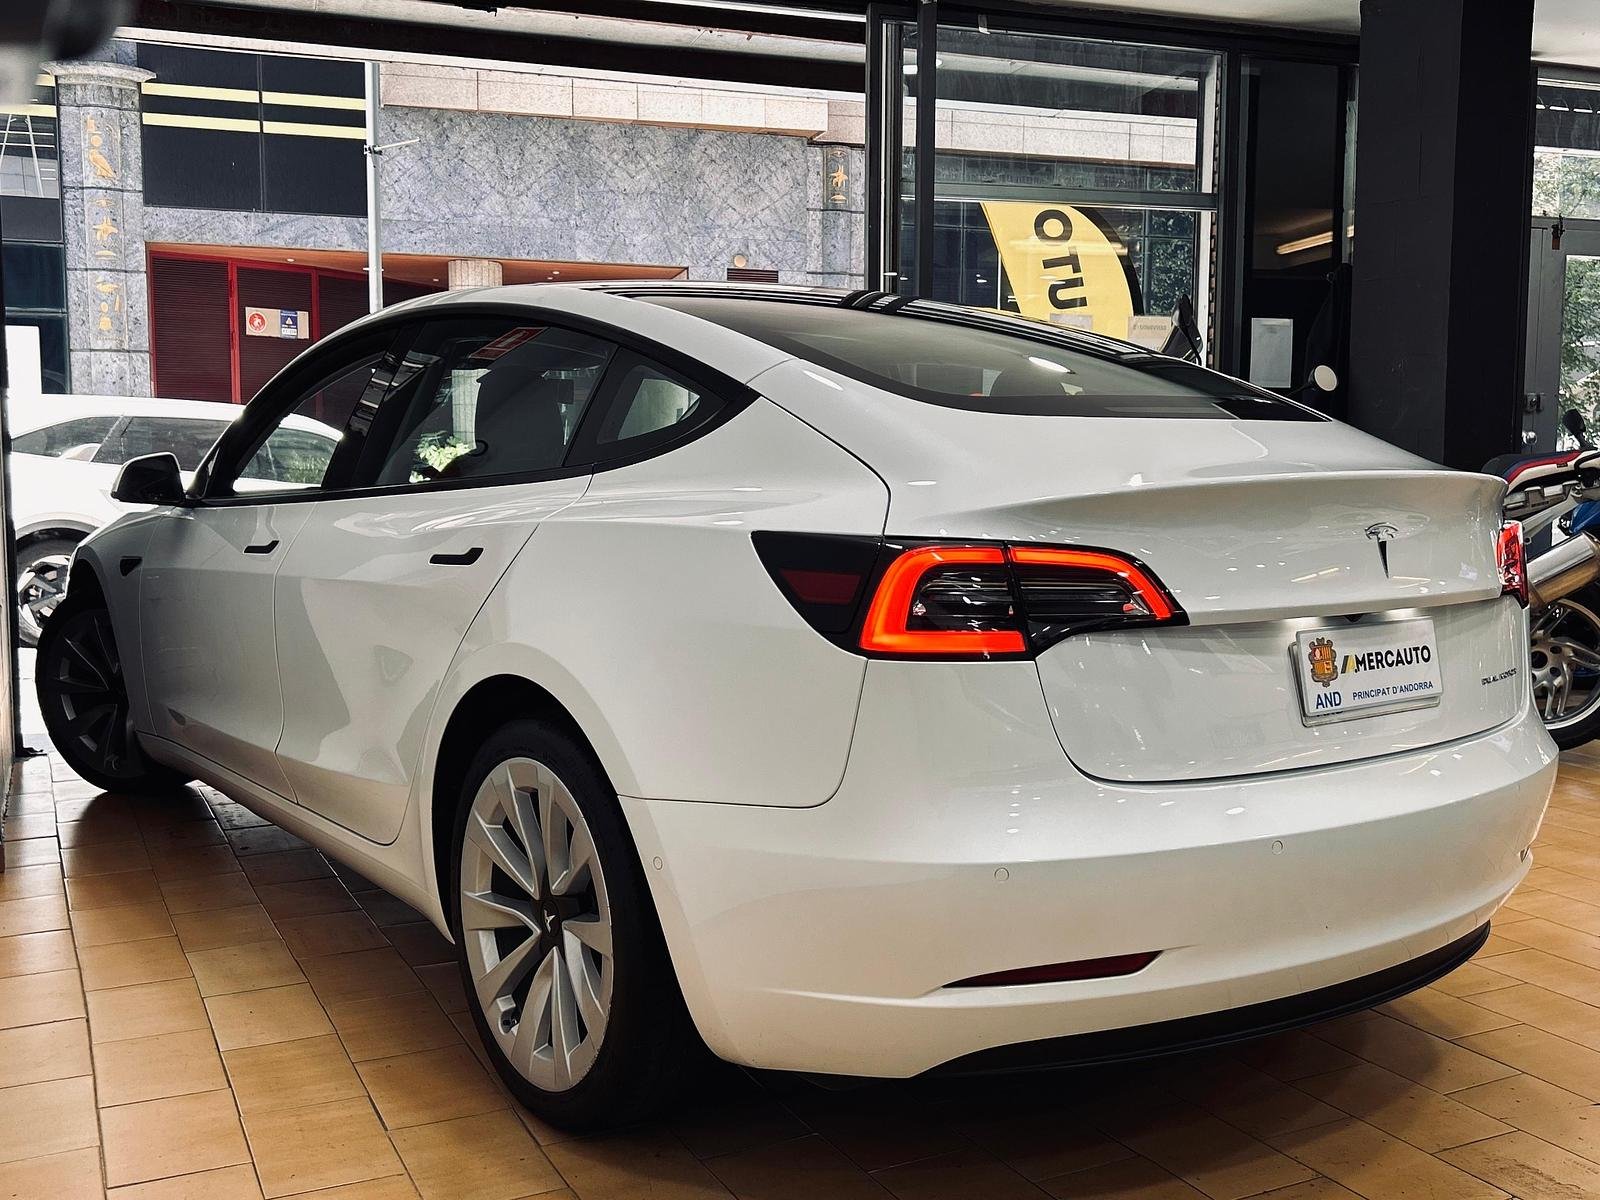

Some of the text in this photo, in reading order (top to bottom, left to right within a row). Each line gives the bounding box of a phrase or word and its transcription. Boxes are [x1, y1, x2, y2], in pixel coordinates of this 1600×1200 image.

[1355, 645, 1431, 673] MERCAUTO
[1316, 691, 1342, 709] AND
[1352, 680, 1434, 701] PRINCIPAT D'ANDORRA
